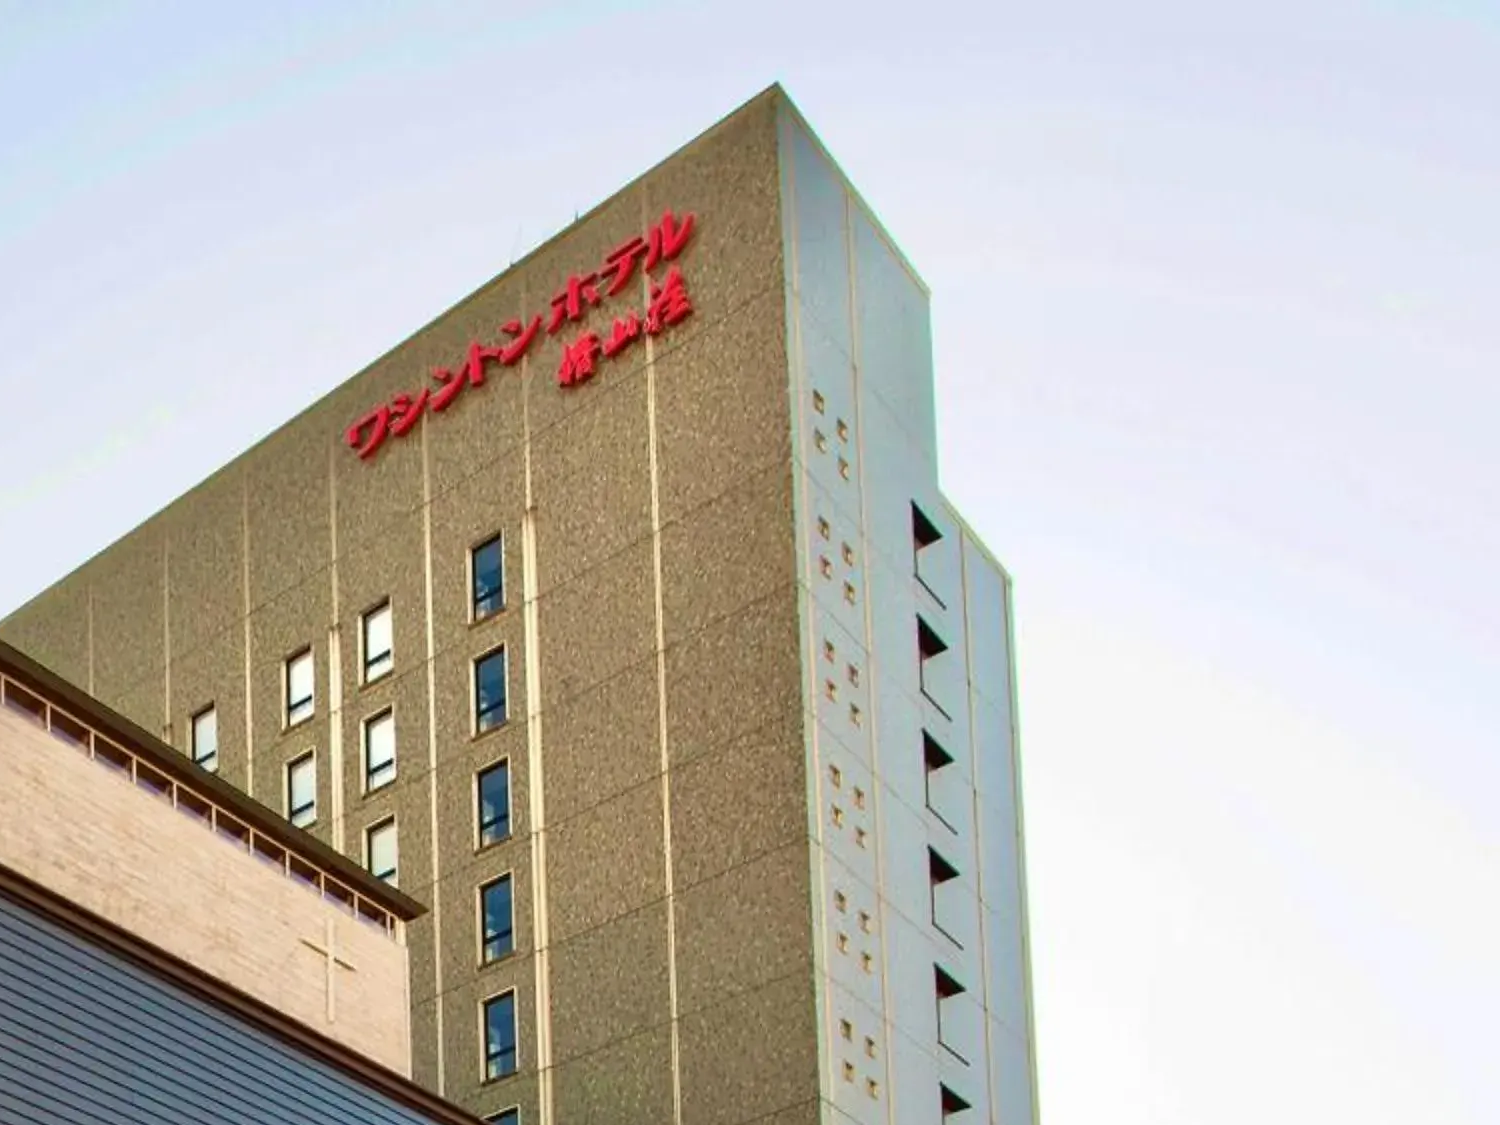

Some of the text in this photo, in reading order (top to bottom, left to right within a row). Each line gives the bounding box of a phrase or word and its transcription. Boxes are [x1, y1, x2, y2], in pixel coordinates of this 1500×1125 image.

[344, 208, 695, 460] ワシントンホテル
